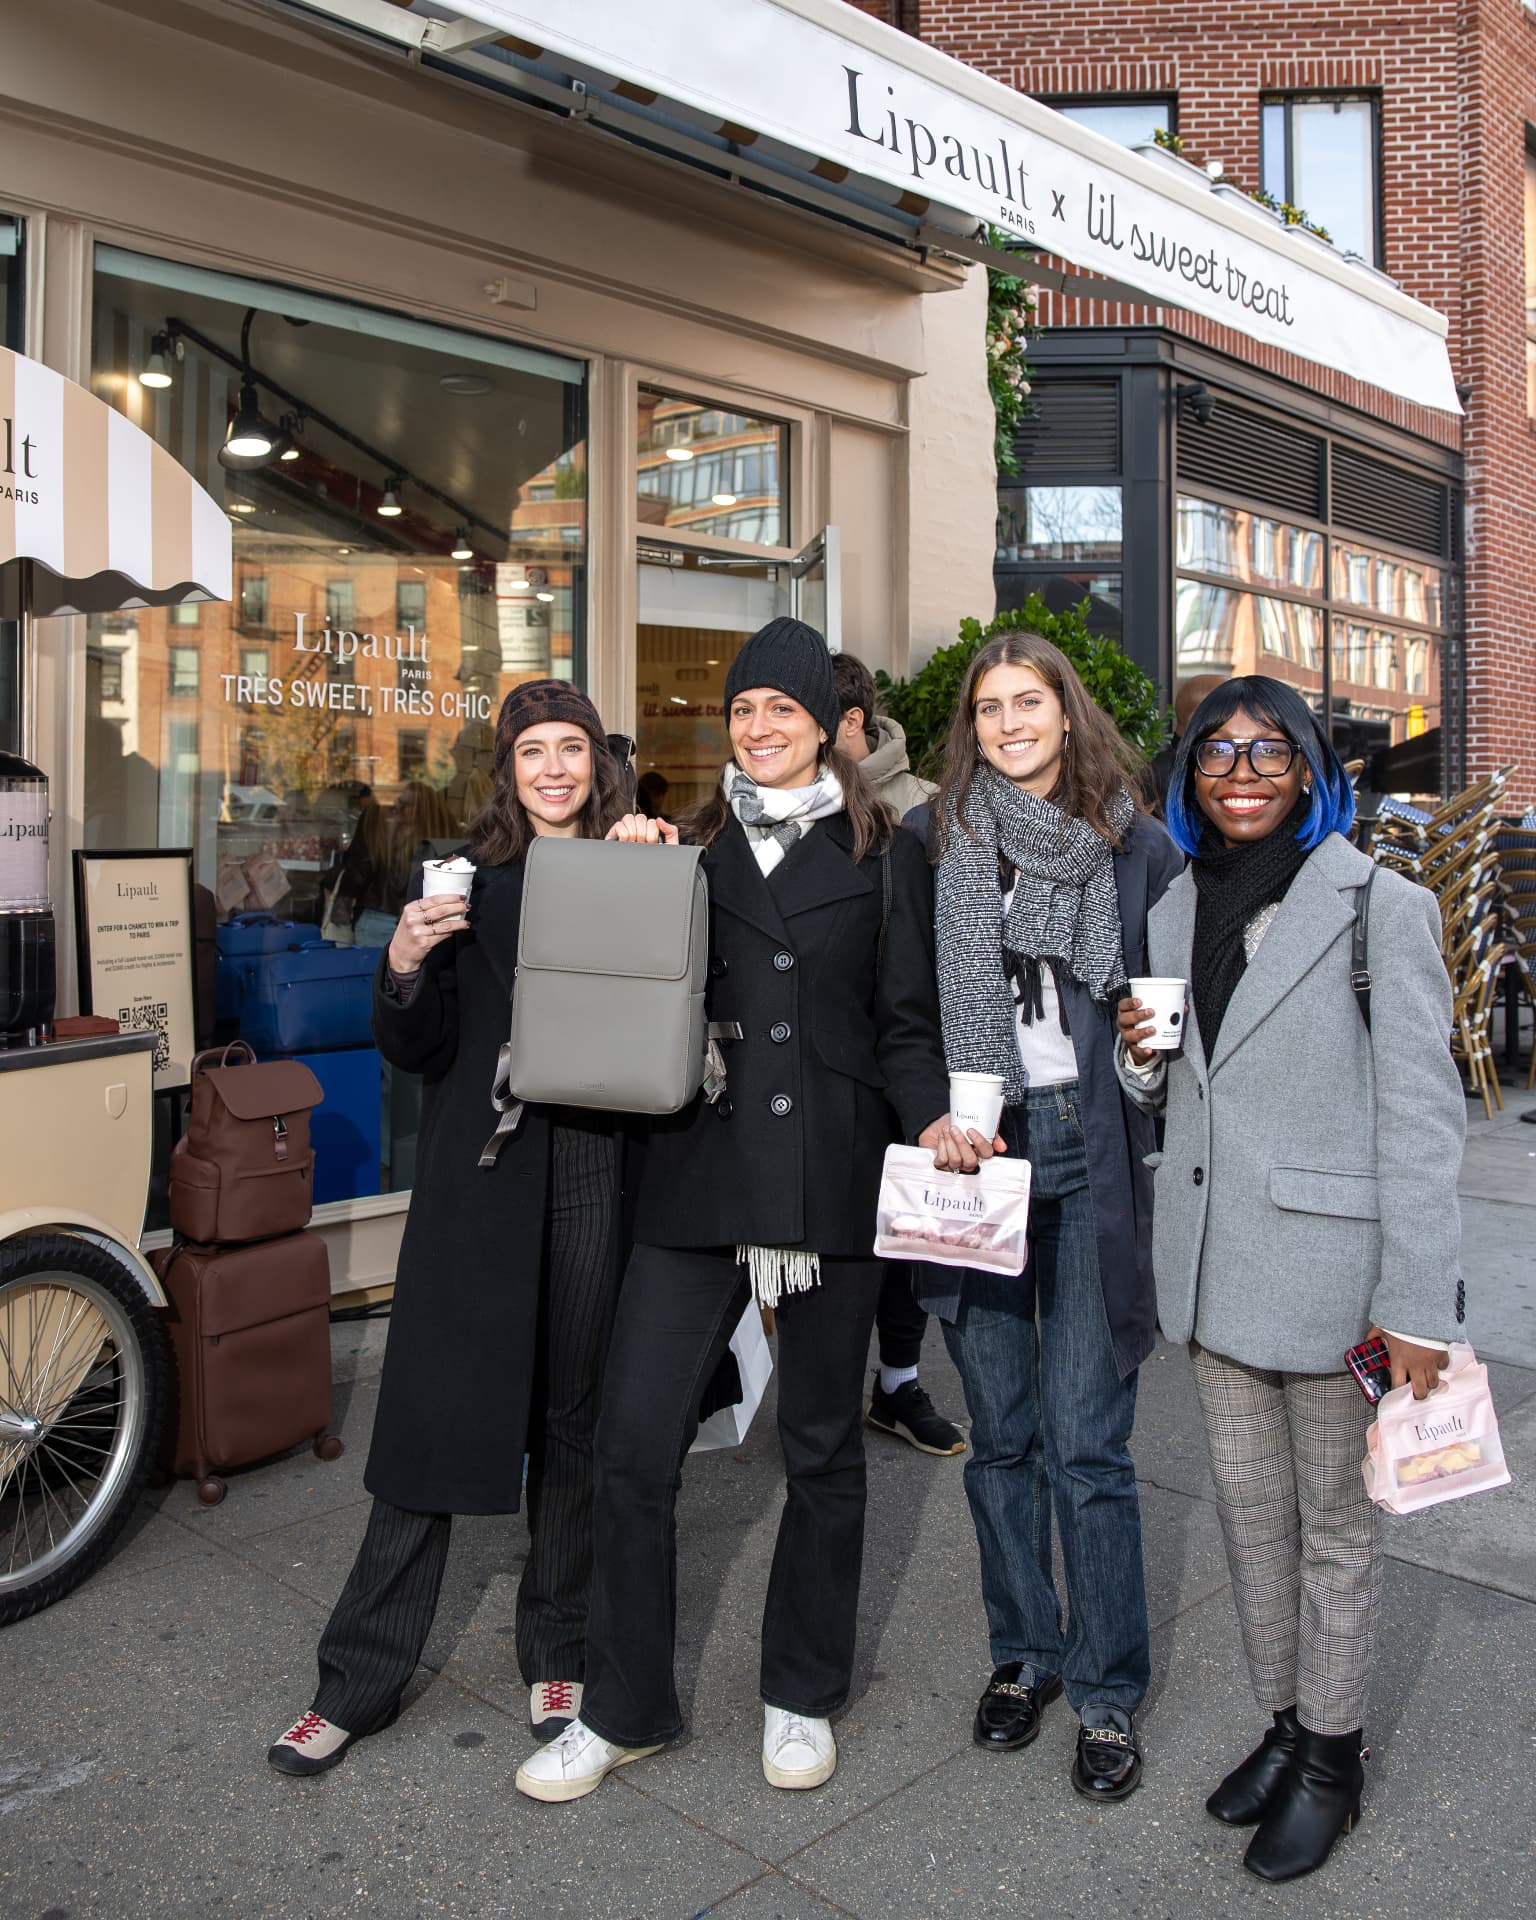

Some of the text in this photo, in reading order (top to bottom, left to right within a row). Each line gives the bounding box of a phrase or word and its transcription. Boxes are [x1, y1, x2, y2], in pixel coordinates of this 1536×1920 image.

[841, 64, 1295, 326] Lipault x lil sweet treat
[1000, 206, 1036, 235] PARIS
[292, 611, 432, 665] Lipault
[401, 668, 432, 680] PARIS
[220, 670, 492, 720] TRÈS SWEET, TRÈS CHIC
[0, 817, 49, 841] ipaul
[117, 882, 158, 900] Lipault
[923, 1190, 984, 1212] Lipault
[1414, 1415, 1464, 1442] Lipault
